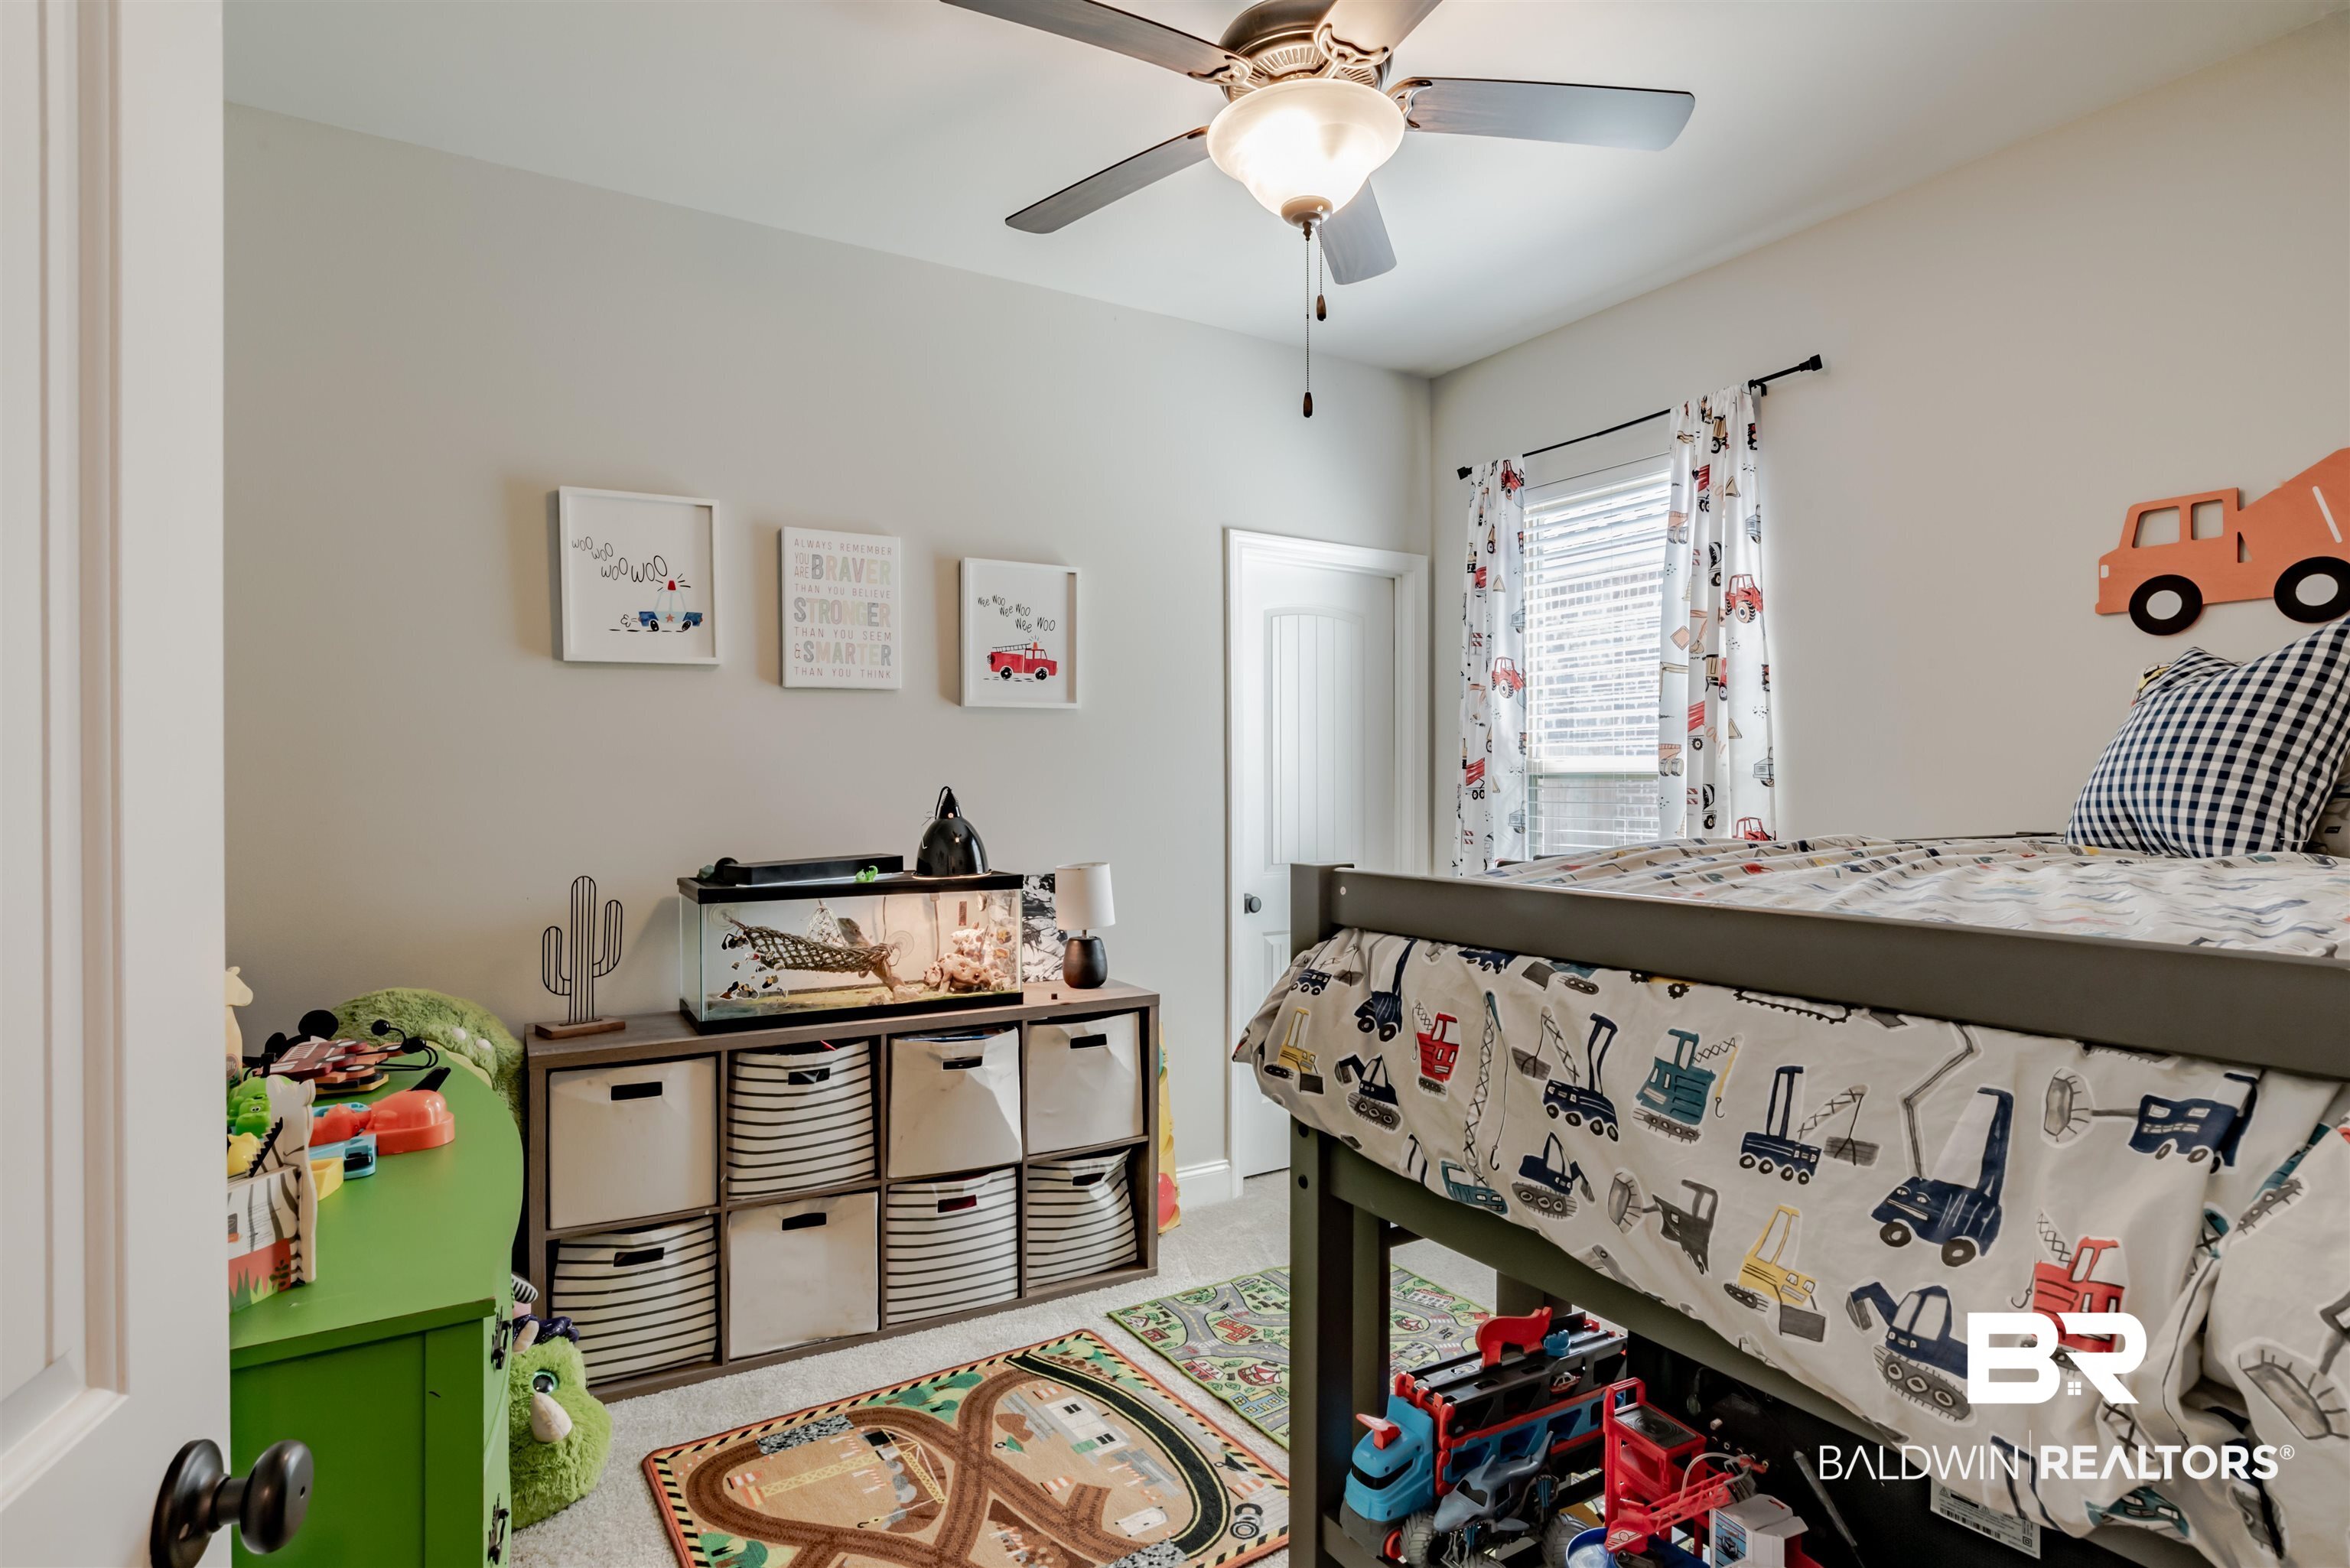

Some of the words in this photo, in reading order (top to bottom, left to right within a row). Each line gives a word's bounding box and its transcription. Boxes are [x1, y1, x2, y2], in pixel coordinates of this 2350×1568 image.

[794, 538, 832, 551] ALWAYS
[840, 543, 892, 555] REMEMBER
[795, 552, 809, 565] YOU
[794, 566, 809, 579] ARE
[812, 554, 891, 585] BRAVER
[795, 584, 820, 594] THAN
[828, 586, 845, 595] YOU
[852, 587, 890, 599] BELIEVE
[794, 597, 891, 628] STRONGER
[794, 626, 824, 638] THAN
[834, 629, 854, 639] YOU
[863, 631, 891, 642] SEEM
[803, 640, 891, 666] SMARTER
[794, 666, 823, 676] THAN
[832, 668, 851, 678] YOU
[860, 669, 891, 679] THINK
